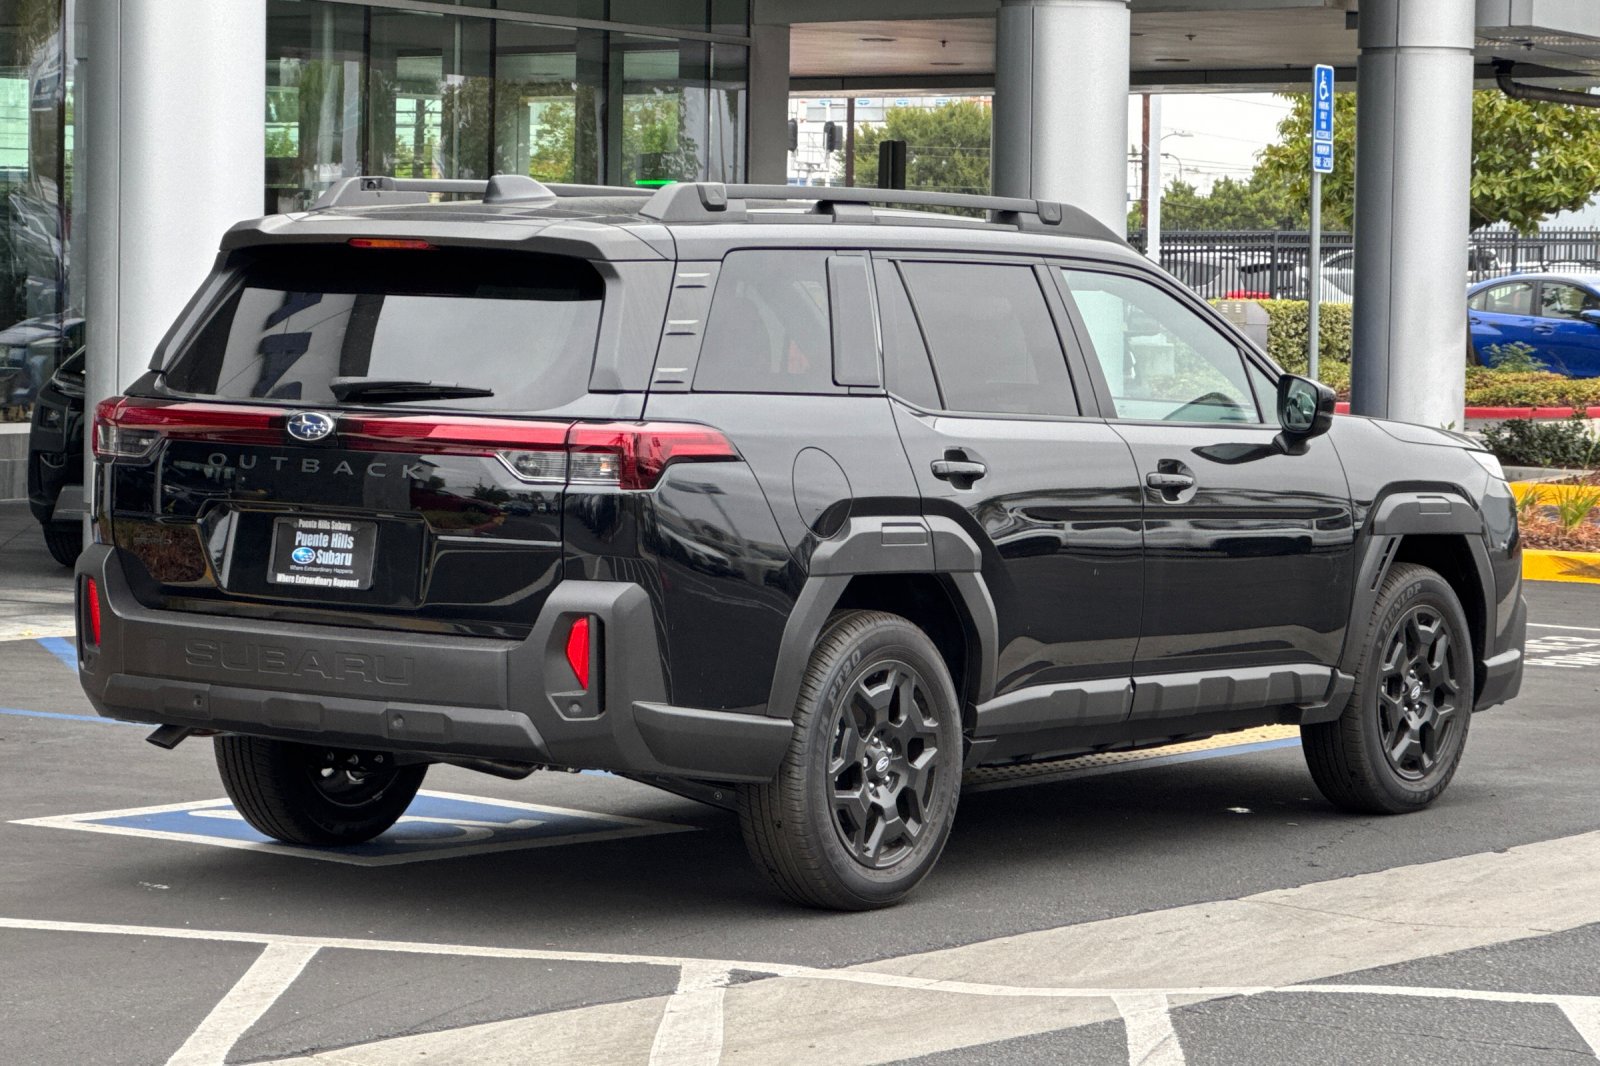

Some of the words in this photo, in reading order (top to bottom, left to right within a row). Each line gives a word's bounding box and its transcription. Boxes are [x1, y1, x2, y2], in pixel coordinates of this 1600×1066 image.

[207, 452, 420, 480] OUTBACK
[298, 519, 318, 529] Puente
[318, 520, 331, 530] Hills
[331, 521, 352, 532] Subaru
[295, 531, 329, 547] Puente
[331, 532, 354, 549] Hills
[315, 549, 353, 566] Subaru
[276, 573, 294, 584] Where
[295, 575, 332, 586] Extraordinary
[1382, 582, 1422, 637] DUNLOP
[183, 638, 415, 686] SUBARU
